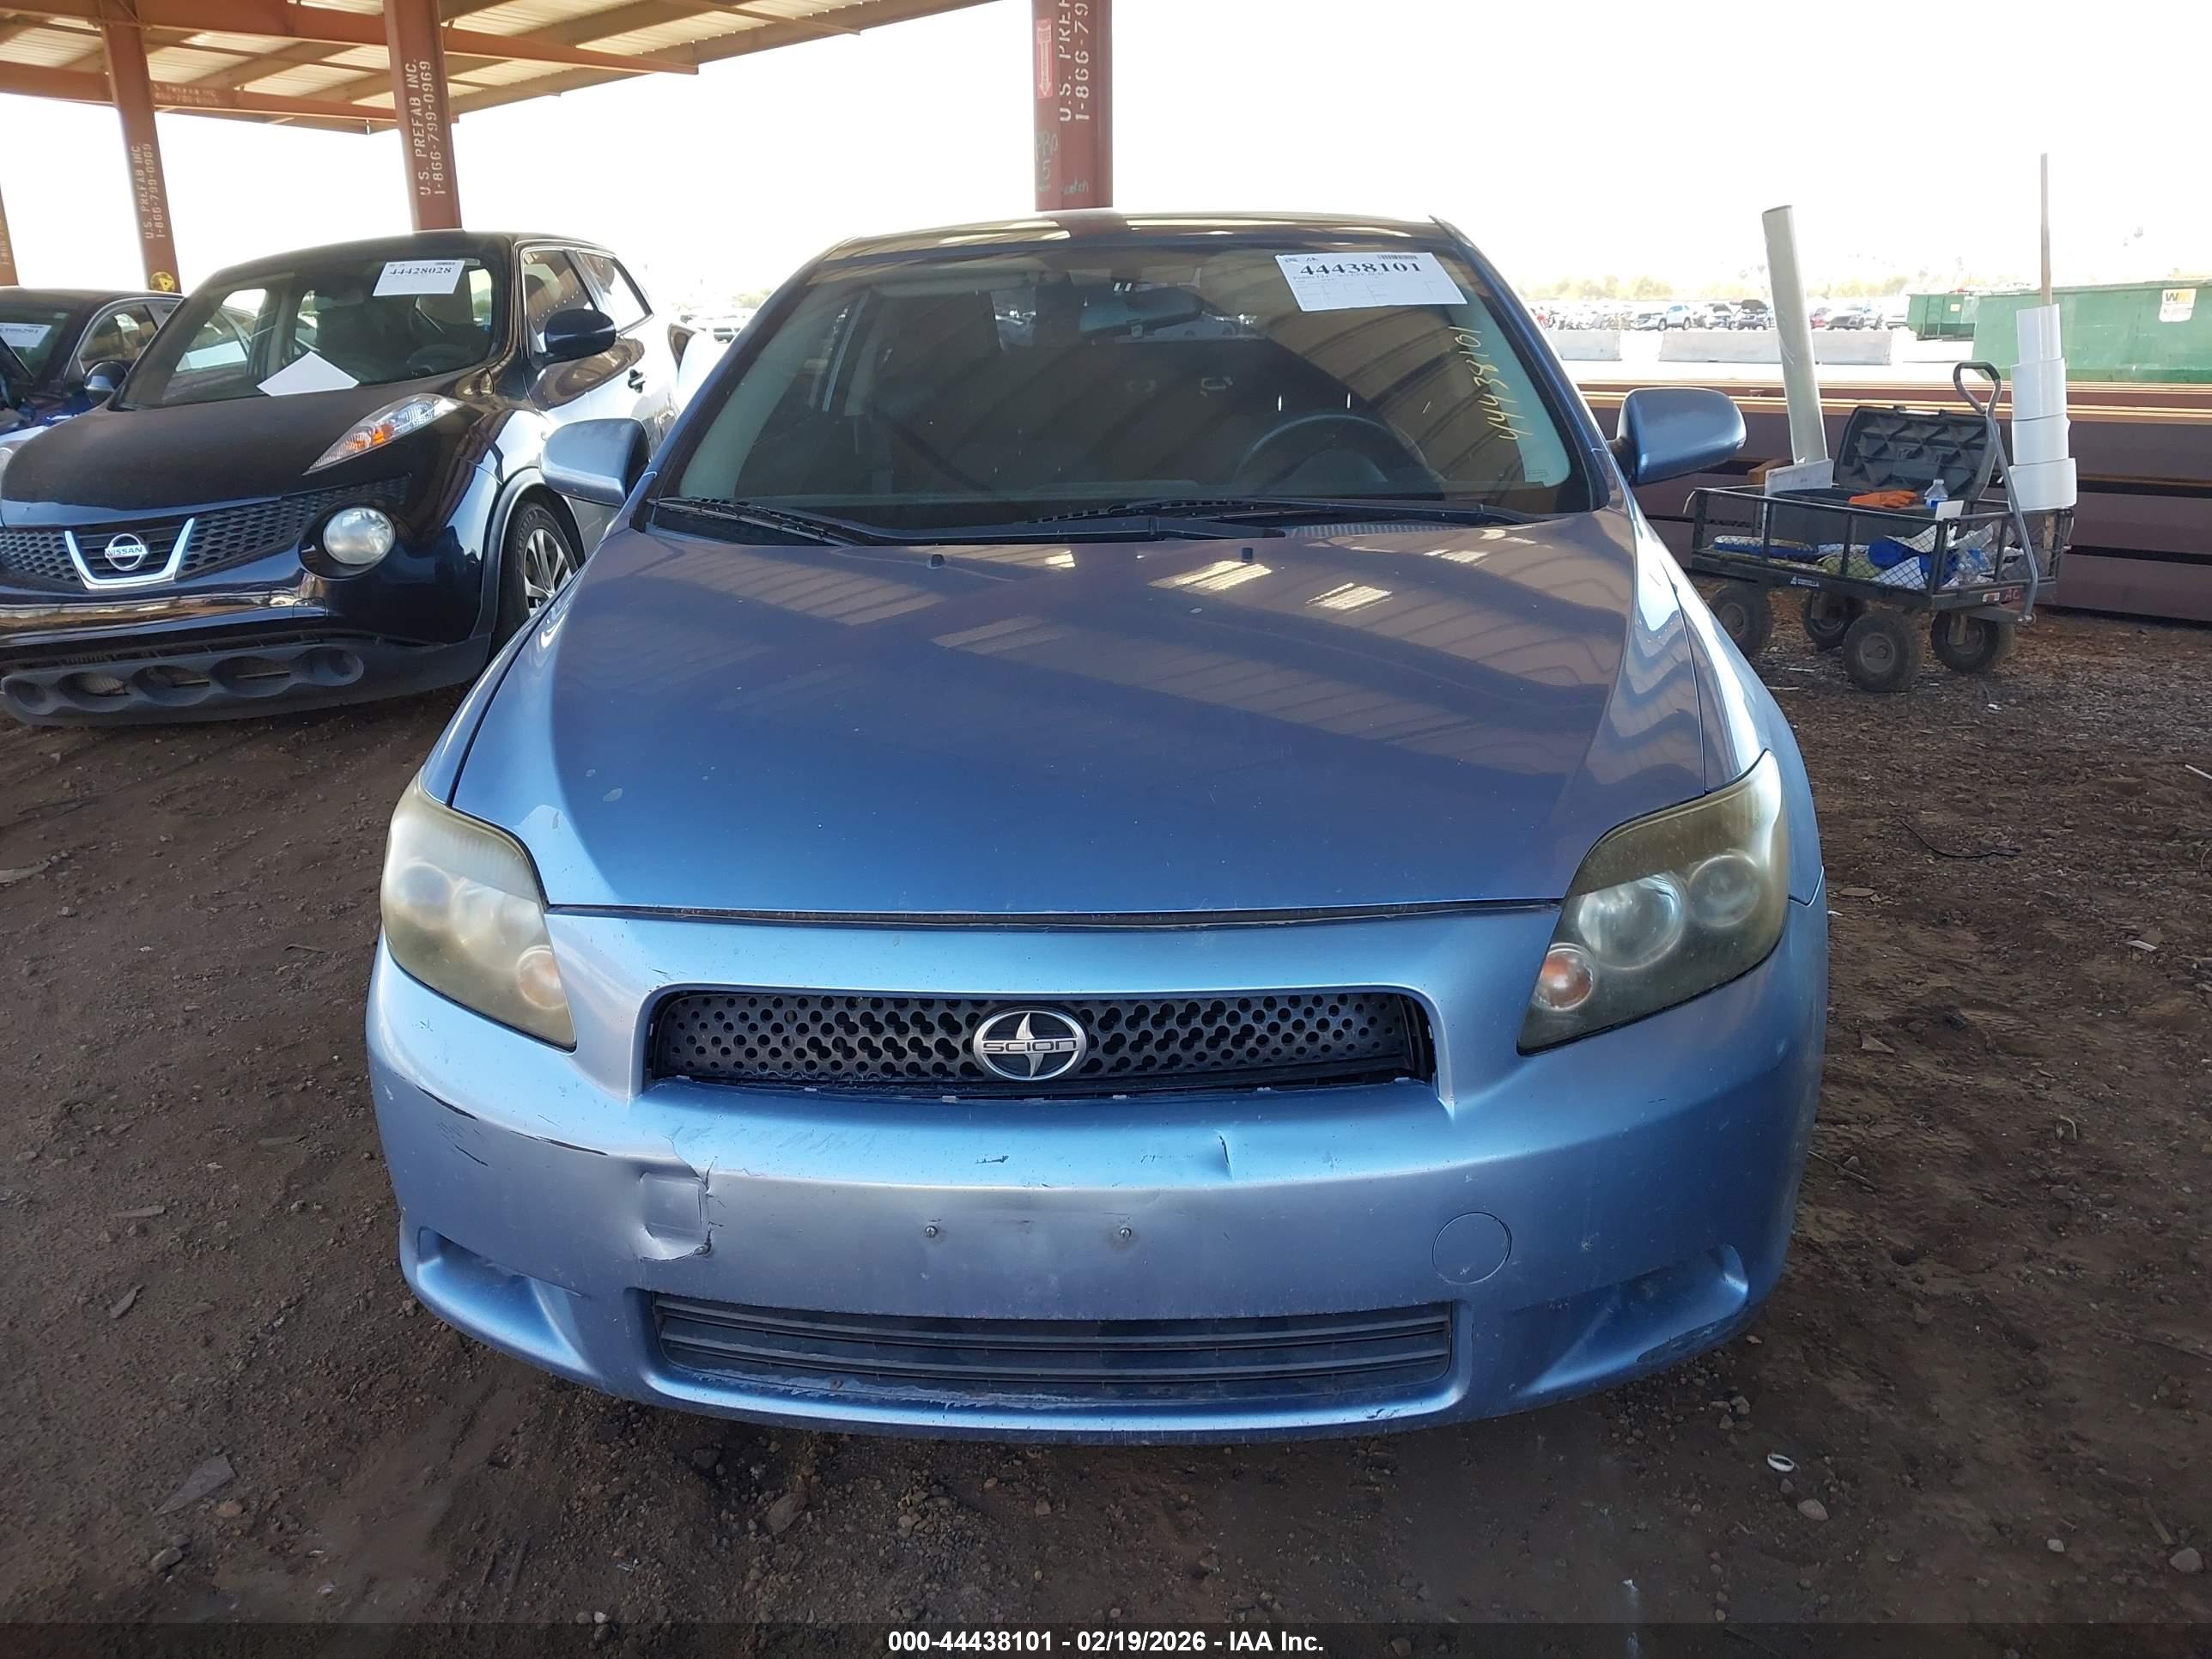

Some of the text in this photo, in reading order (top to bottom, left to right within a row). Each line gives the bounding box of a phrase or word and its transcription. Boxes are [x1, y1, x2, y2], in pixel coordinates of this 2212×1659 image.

[1059, 75, 1072, 122] U.S.
[405, 59, 431, 196] U.S. PREFAB INC.
[420, 61, 446, 195] 1-866-799-0969
[135, 169, 150, 212] PREFAB
[1300, 262, 1423, 276] 44438101
[1449, 326, 1533, 441] 44438101
[106, 547, 143, 556] NISSAN
[983, 1040, 1077, 1053] SCION
